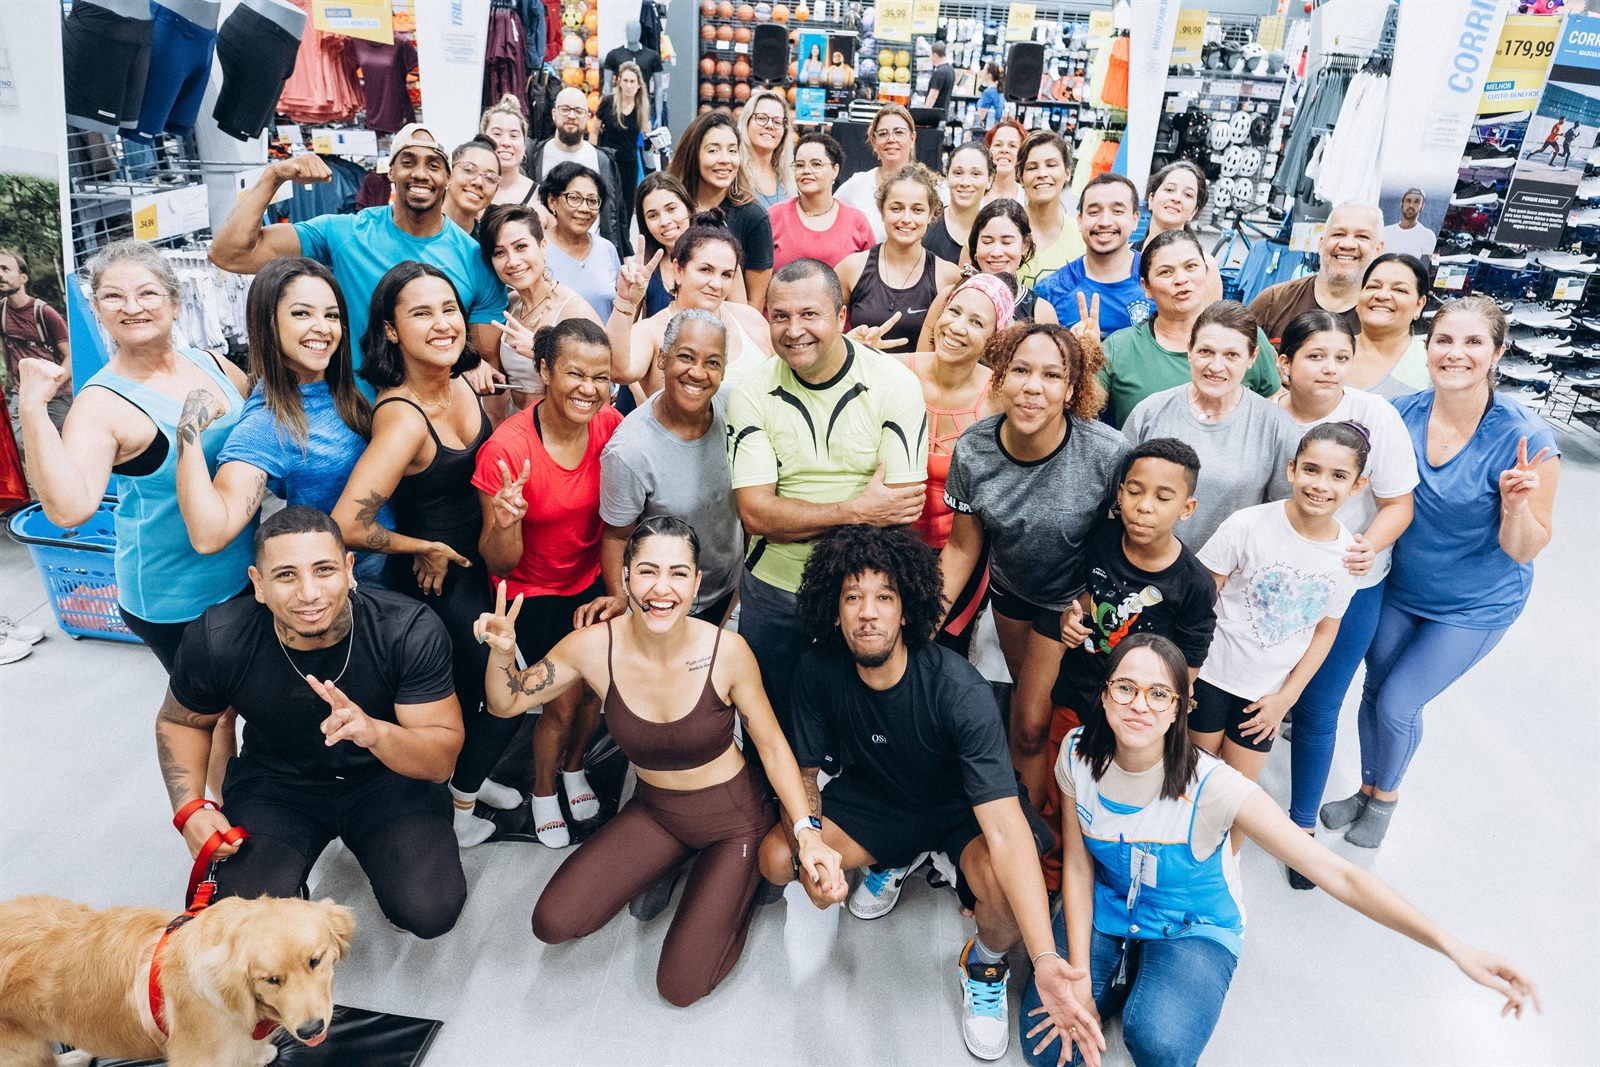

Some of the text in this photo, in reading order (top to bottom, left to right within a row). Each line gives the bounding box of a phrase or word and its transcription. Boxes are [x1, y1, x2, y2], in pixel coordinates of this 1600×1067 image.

[1182, 25, 1202, 35] 99,99
[1504, 39, 1555, 59] 179,99
[1486, 82, 1512, 90] MELHOR
